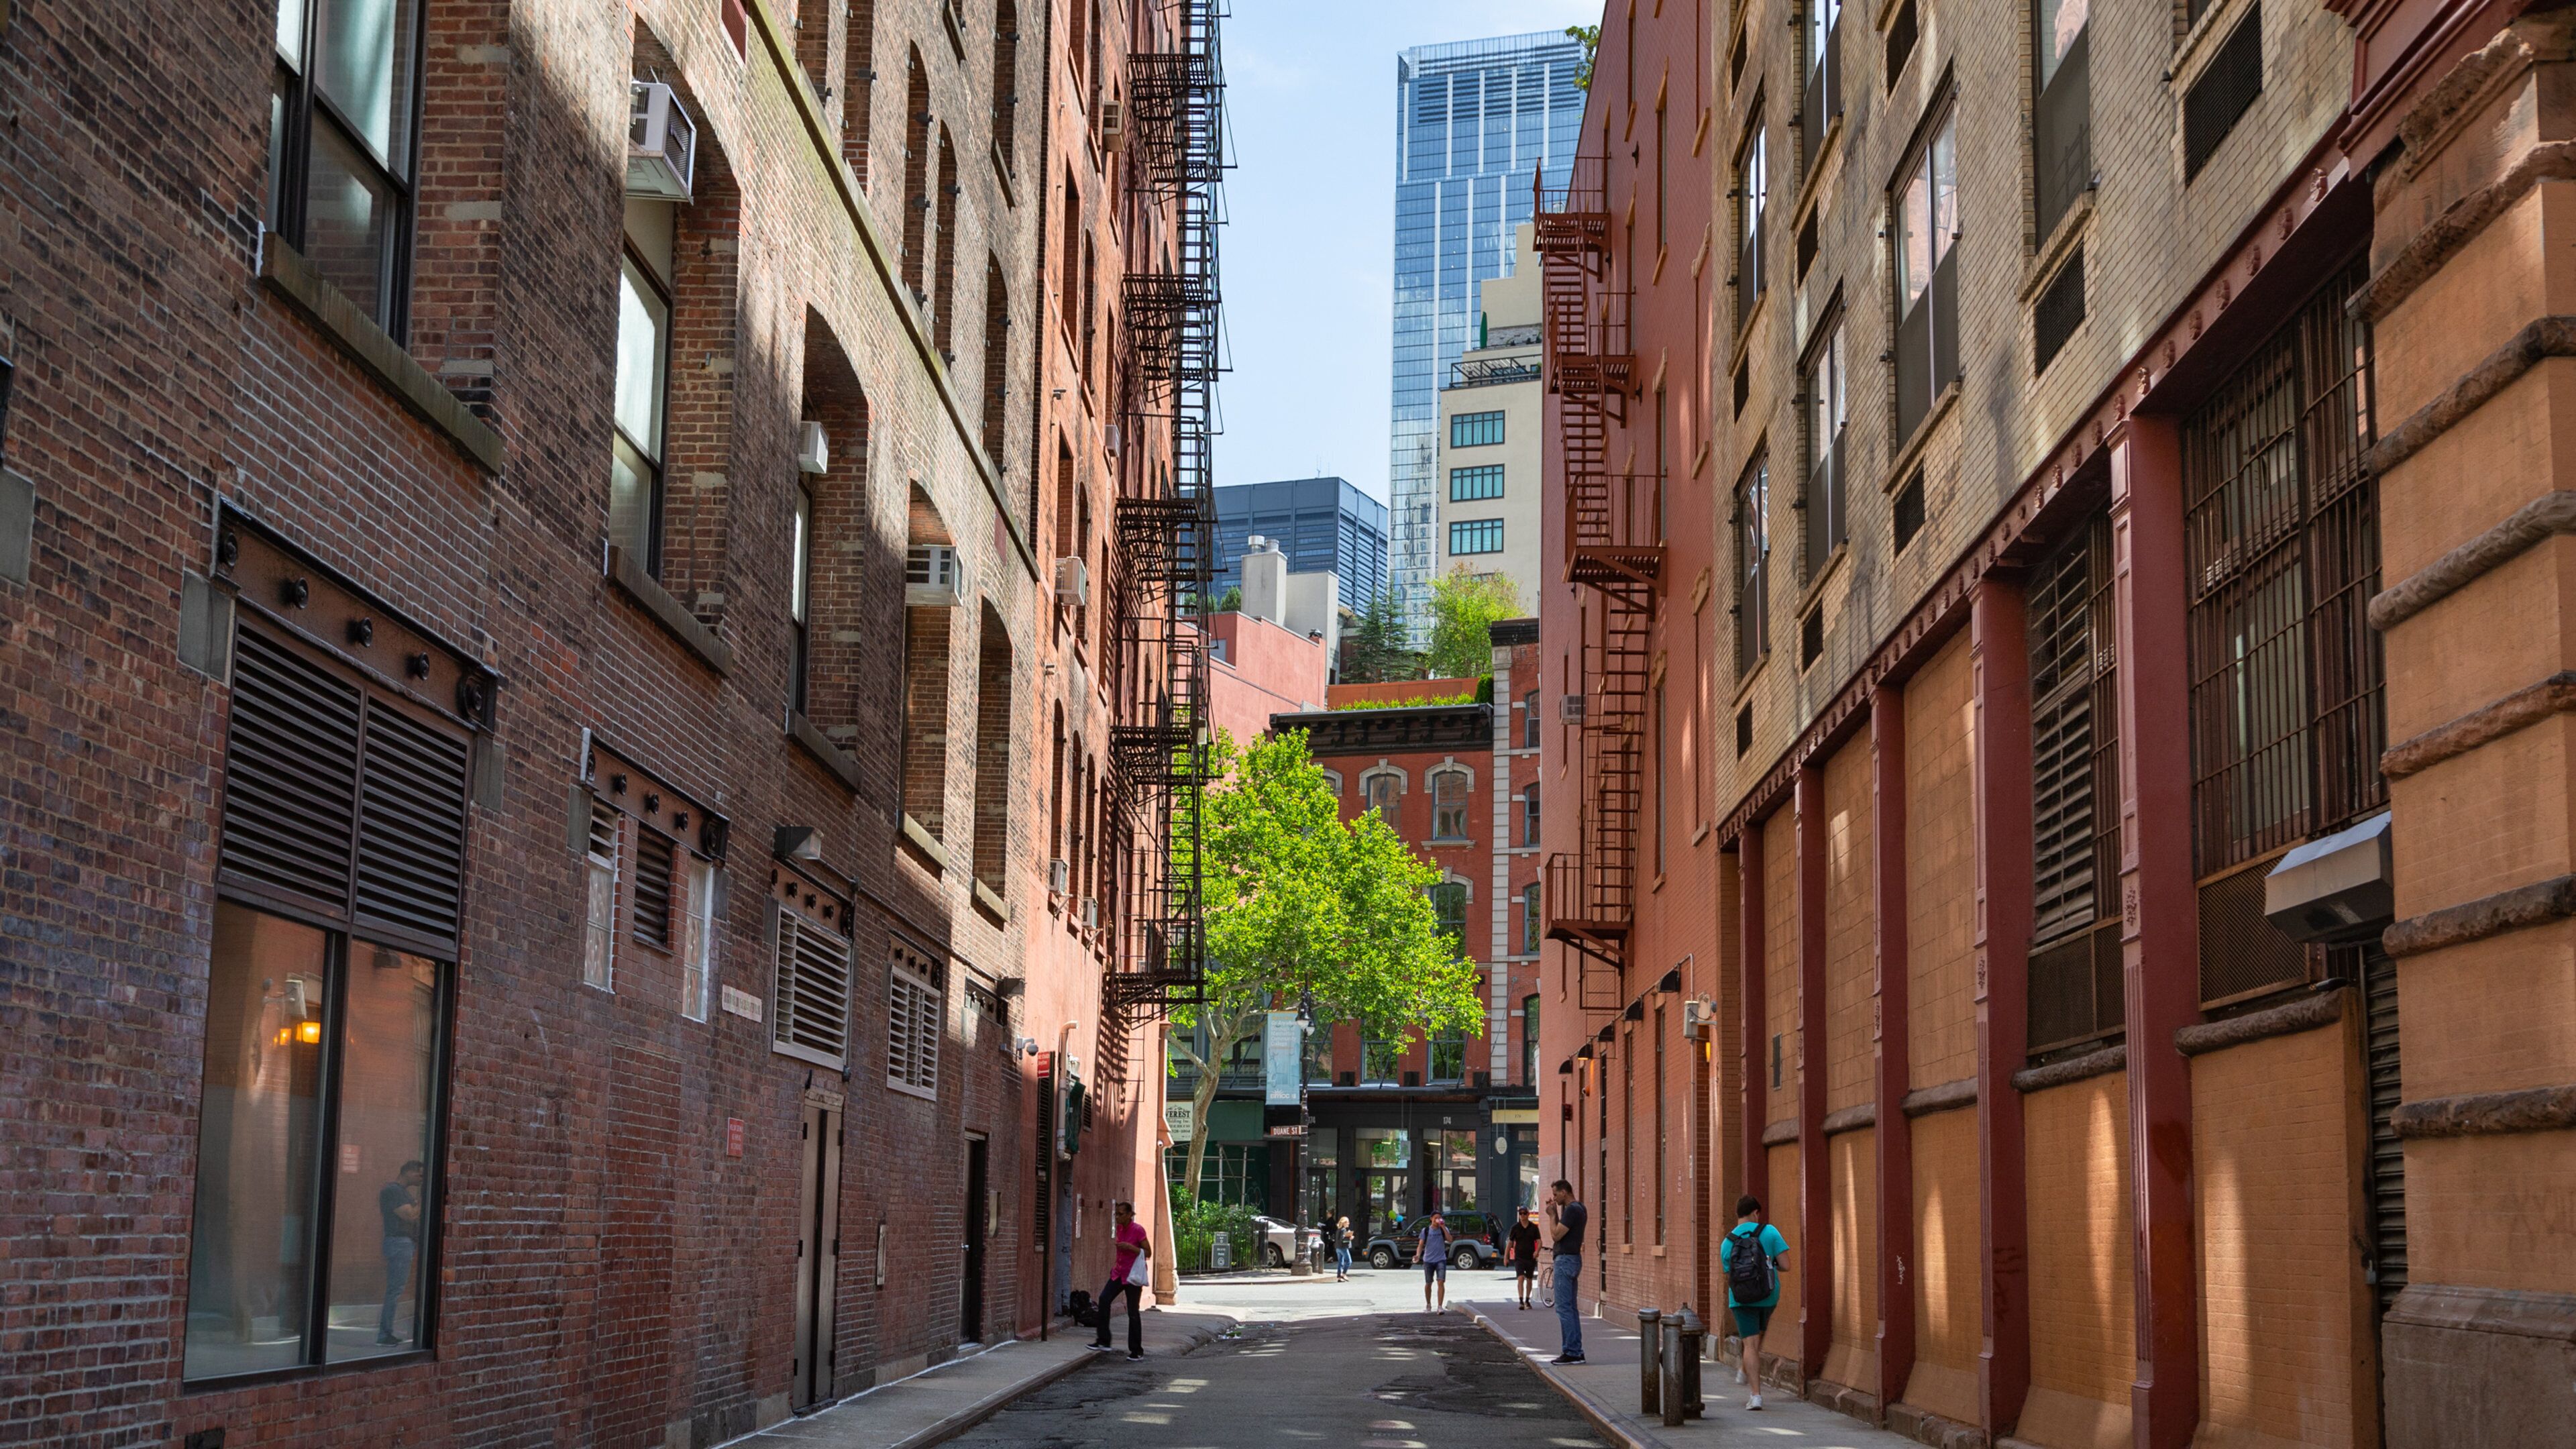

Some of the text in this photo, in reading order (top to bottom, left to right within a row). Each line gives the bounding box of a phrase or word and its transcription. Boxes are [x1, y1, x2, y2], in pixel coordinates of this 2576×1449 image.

[1443, 1116, 1451, 1124] 174
[1273, 1126, 1298, 1135] DUANE ST
